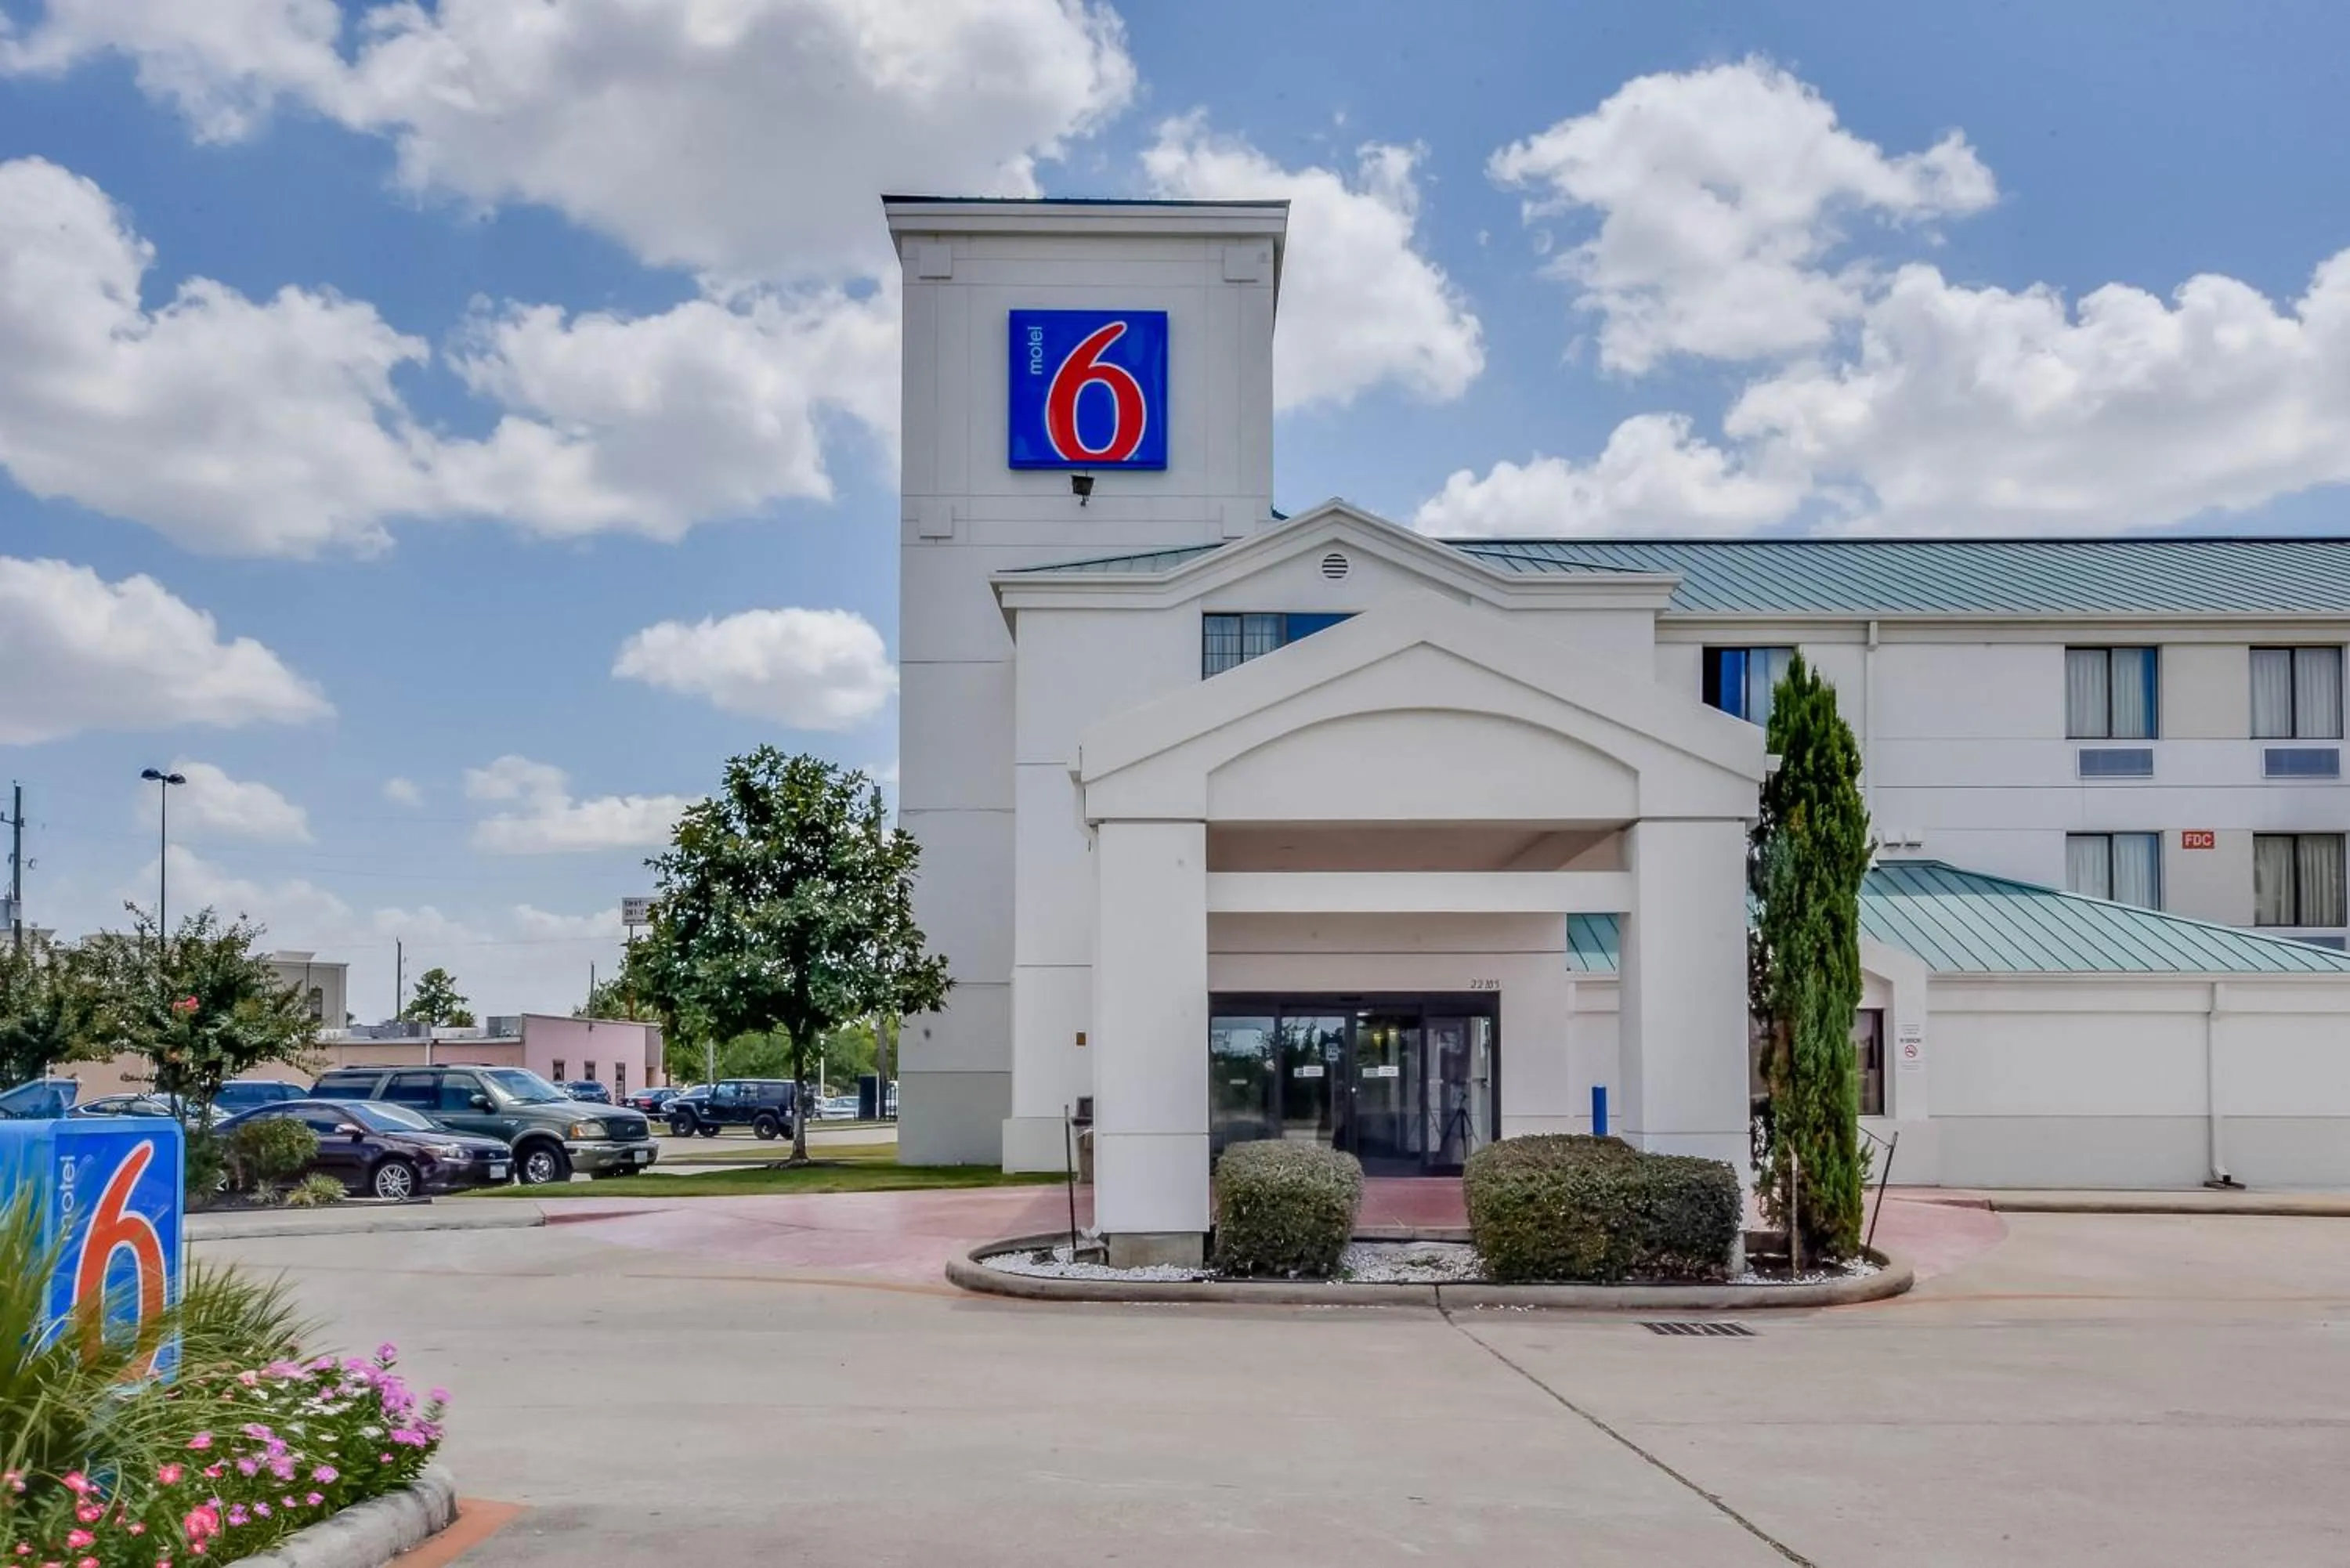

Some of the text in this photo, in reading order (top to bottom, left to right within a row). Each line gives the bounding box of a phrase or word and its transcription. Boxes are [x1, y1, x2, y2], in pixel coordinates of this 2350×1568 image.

[1027, 325, 1043, 375] motel
[1044, 320, 1148, 461] 6
[2185, 833, 2212, 846] FDC
[72, 1139, 168, 1378] 6
